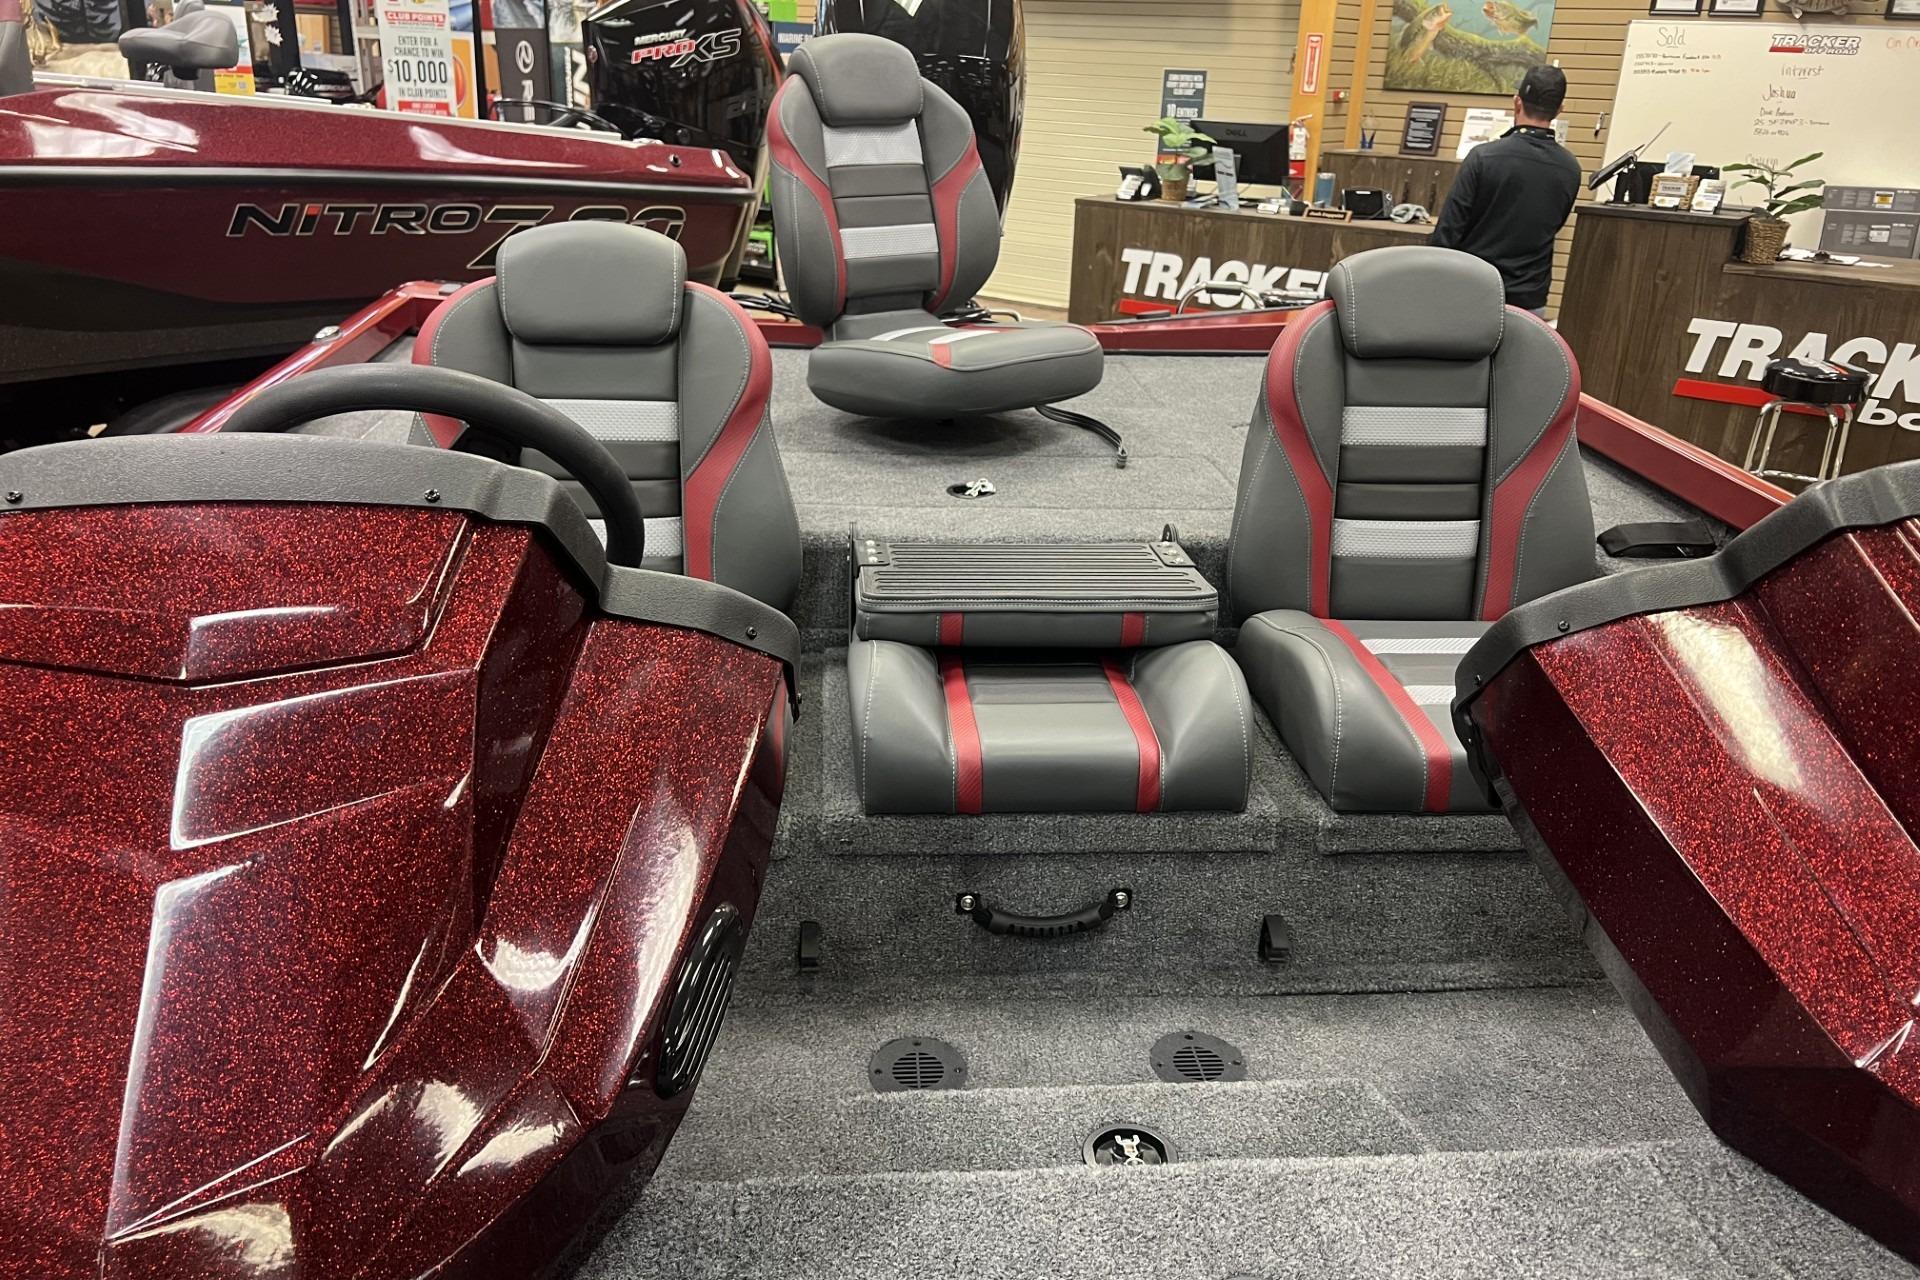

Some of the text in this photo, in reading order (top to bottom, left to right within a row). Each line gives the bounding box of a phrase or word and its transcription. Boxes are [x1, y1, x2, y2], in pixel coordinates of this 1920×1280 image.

[387, 12, 445, 23] CLUB POINTS
[398, 36, 417, 45] ENTER
[419, 37, 432, 46] FOR
[634, 29, 687, 45] MERCURY
[1657, 26, 1686, 47] Sold
[1772, 34, 1861, 48] TRACKER
[394, 47, 443, 58] CHANCE TO WIN
[631, 28, 741, 68] PRO XS
[1804, 46, 1858, 56] OFF ROAD
[388, 59, 447, 86] $10,000
[406, 88, 423, 98] CLUB
[425, 88, 447, 98] POINTS
[1225, 128, 1248, 138] DELL
[226, 204, 482, 237] NITRO
[1121, 248, 1328, 310] TRACKE
